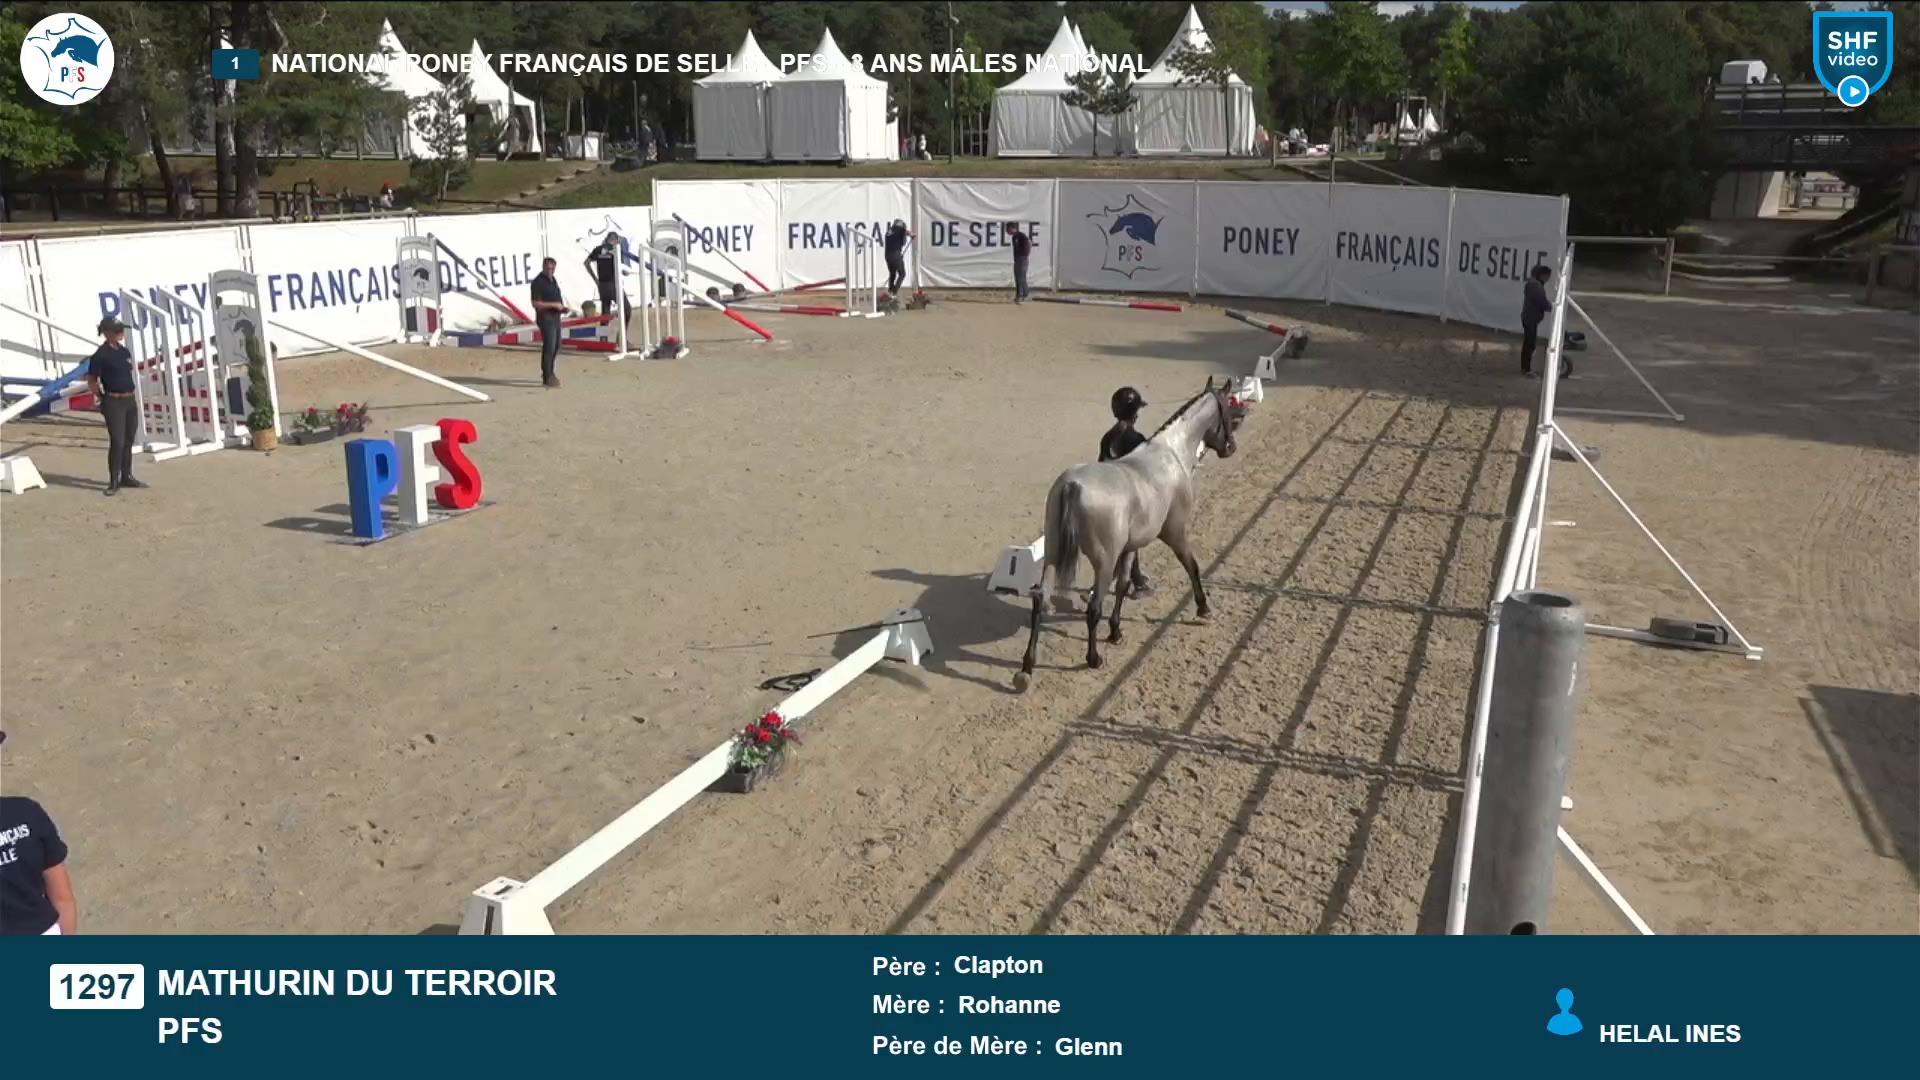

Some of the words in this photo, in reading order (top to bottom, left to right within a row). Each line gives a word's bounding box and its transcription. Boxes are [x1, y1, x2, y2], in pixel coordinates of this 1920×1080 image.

[686, 224, 754, 254] PONEY
[931, 221, 961, 247] DE
[968, 221, 1041, 248] SELE
[1223, 226, 1300, 256] PONEY
[1336, 231, 1440, 271] FRANÇAIS
[437, 257, 468, 293] DE
[474, 252, 534, 290] SELLE
[1459, 241, 1481, 275] DE
[344, 418, 482, 538] PFS
